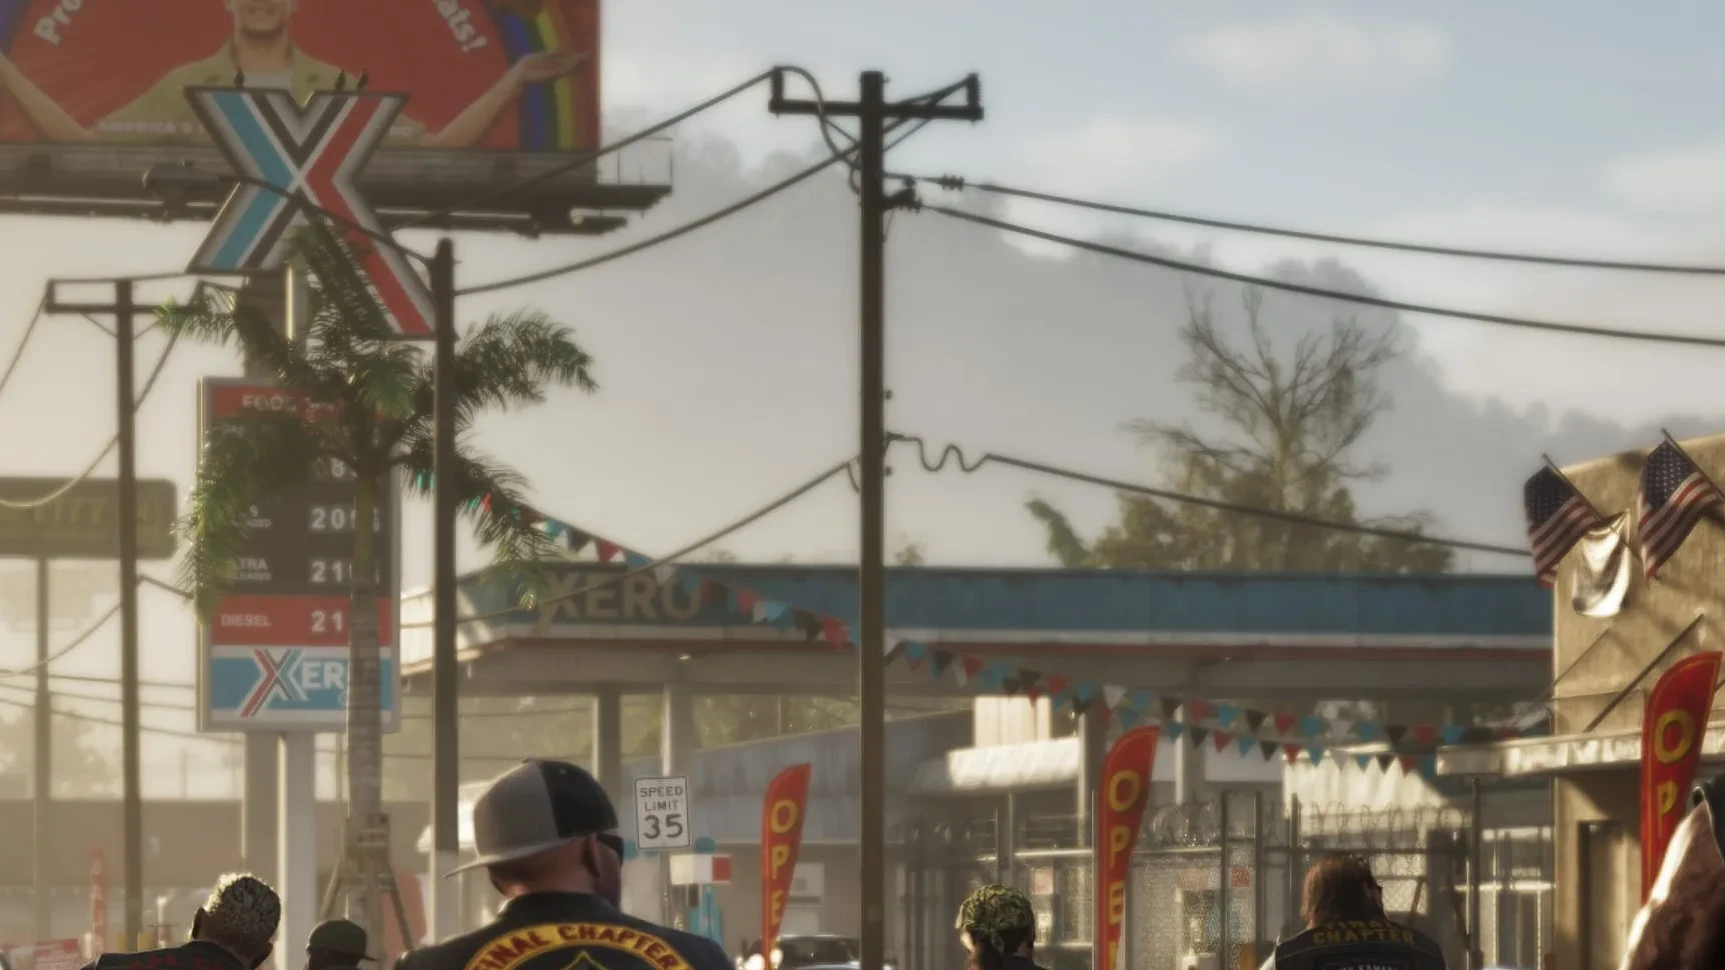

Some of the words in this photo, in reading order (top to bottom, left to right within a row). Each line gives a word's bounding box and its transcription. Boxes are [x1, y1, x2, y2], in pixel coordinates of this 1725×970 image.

[311, 560, 344, 583] 21
[531, 570, 702, 636] XERO
[221, 614, 272, 627] DIESEL
[311, 610, 344, 633] 21
[238, 649, 346, 718] XER
[640, 785, 684, 798] SPEED
[644, 800, 679, 812] LIMIT
[643, 814, 684, 839] 35
[771, 799, 798, 930] OPE
[470, 931, 552, 970] INAL
[556, 925, 681, 970] CHAPTER
[1312, 928, 1415, 947] CHAPTER
